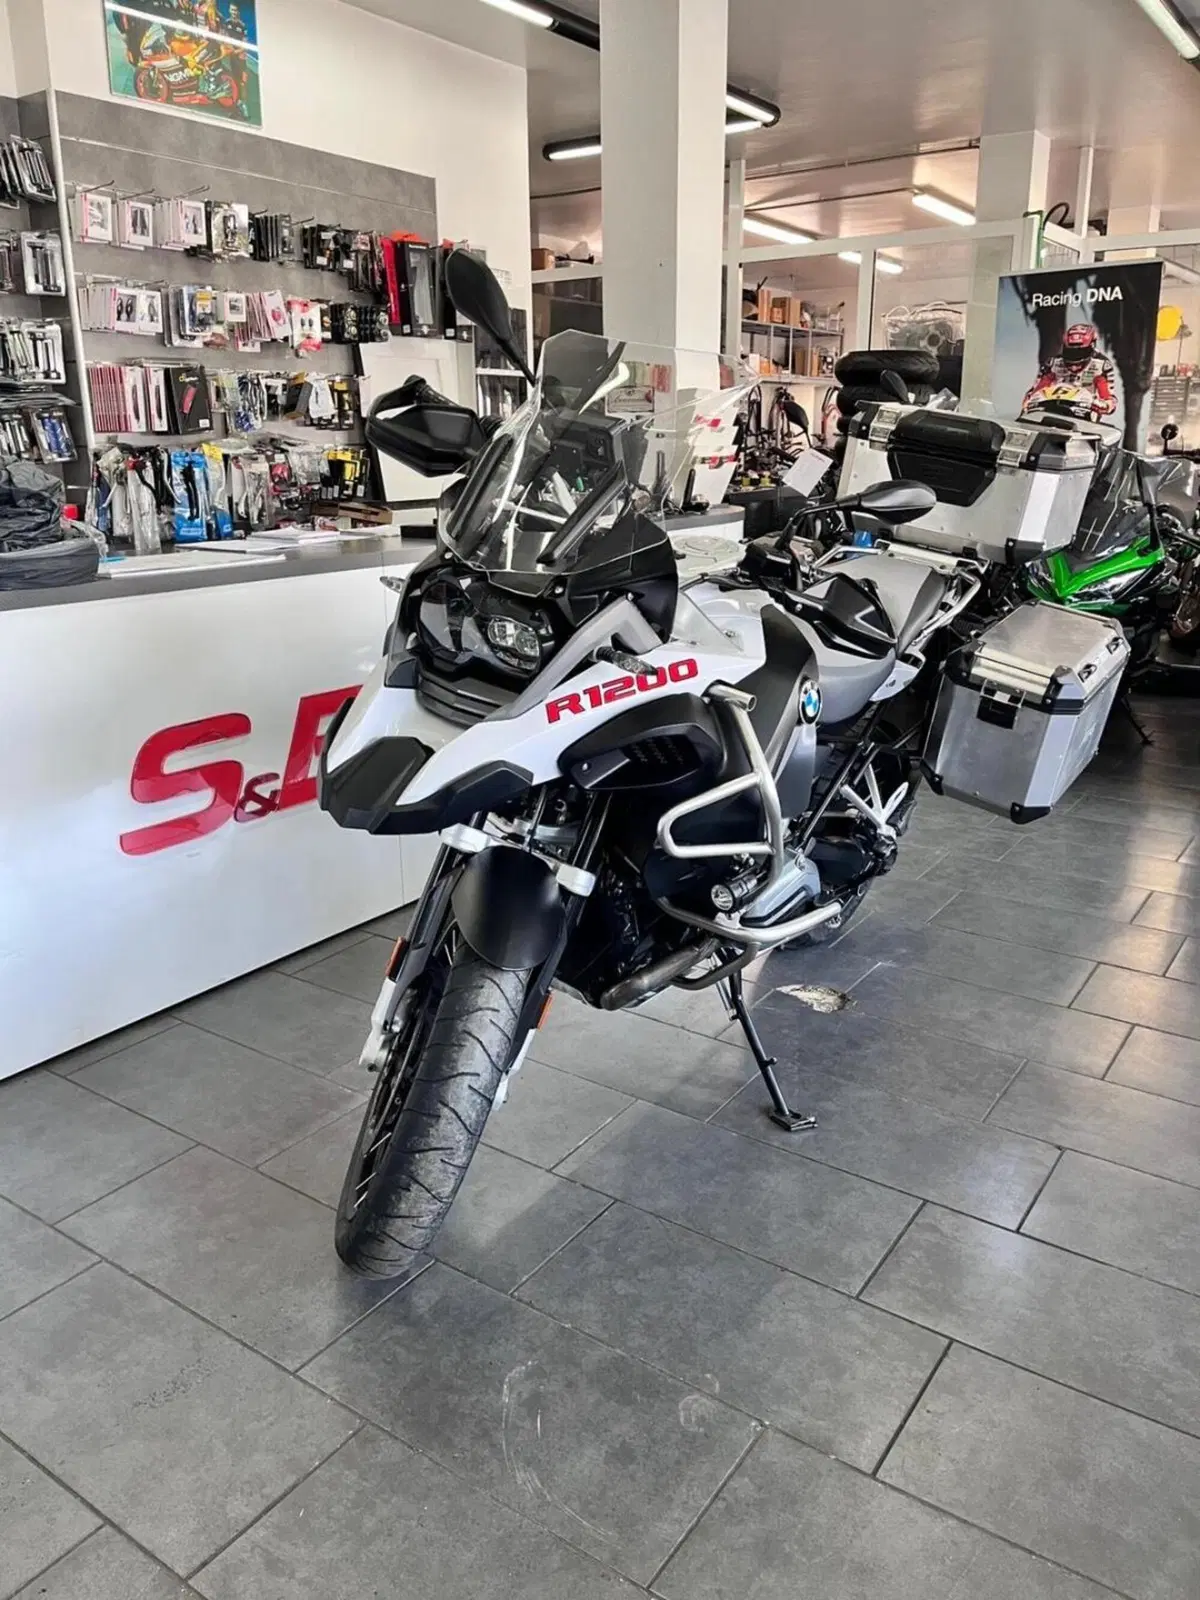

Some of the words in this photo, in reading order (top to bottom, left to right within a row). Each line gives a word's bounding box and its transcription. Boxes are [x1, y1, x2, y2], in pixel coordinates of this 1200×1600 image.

[1032, 292, 1081, 307] Racing
[1086, 286, 1123, 302] DNA
[545, 658, 699, 724] R1200
